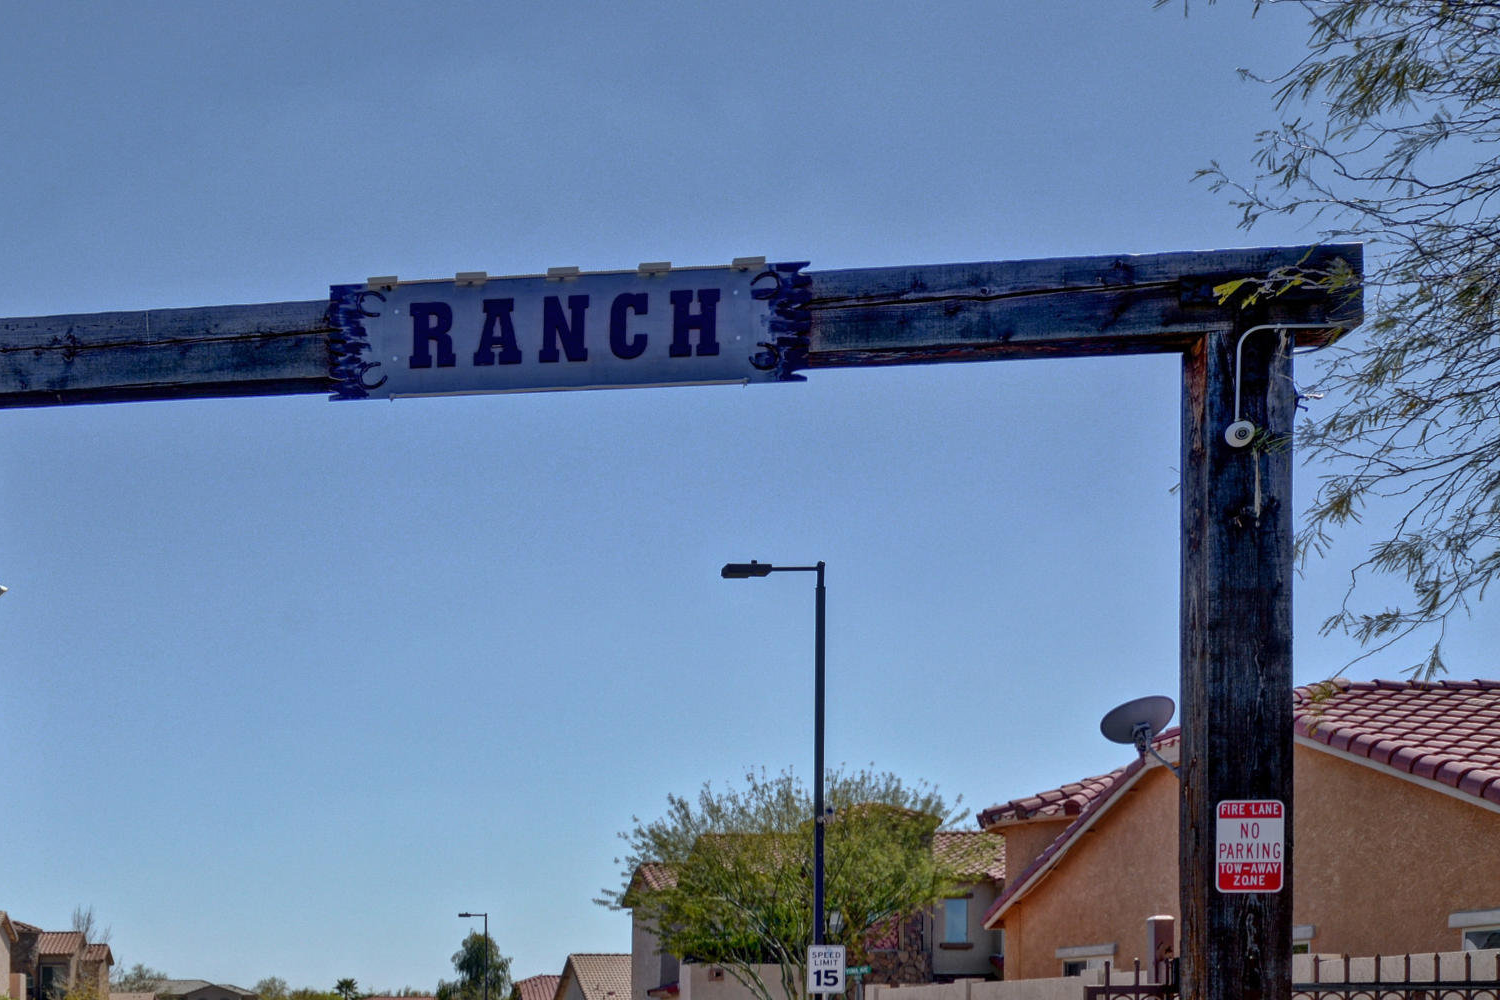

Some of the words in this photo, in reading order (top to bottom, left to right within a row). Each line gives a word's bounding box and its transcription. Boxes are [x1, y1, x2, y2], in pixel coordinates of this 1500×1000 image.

[408, 288, 721, 369] RANCH
[1221, 804, 1245, 815] FIRE
[1251, 803, 1280, 815] LANE
[1240, 822, 1260, 839] NO
[1219, 842, 1281, 859] PARKING
[1220, 863, 1280, 874] TOW-AWAY
[1233, 875, 1266, 886] ZONE
[811, 951, 841, 959] SPEED
[813, 969, 839, 987] 15
